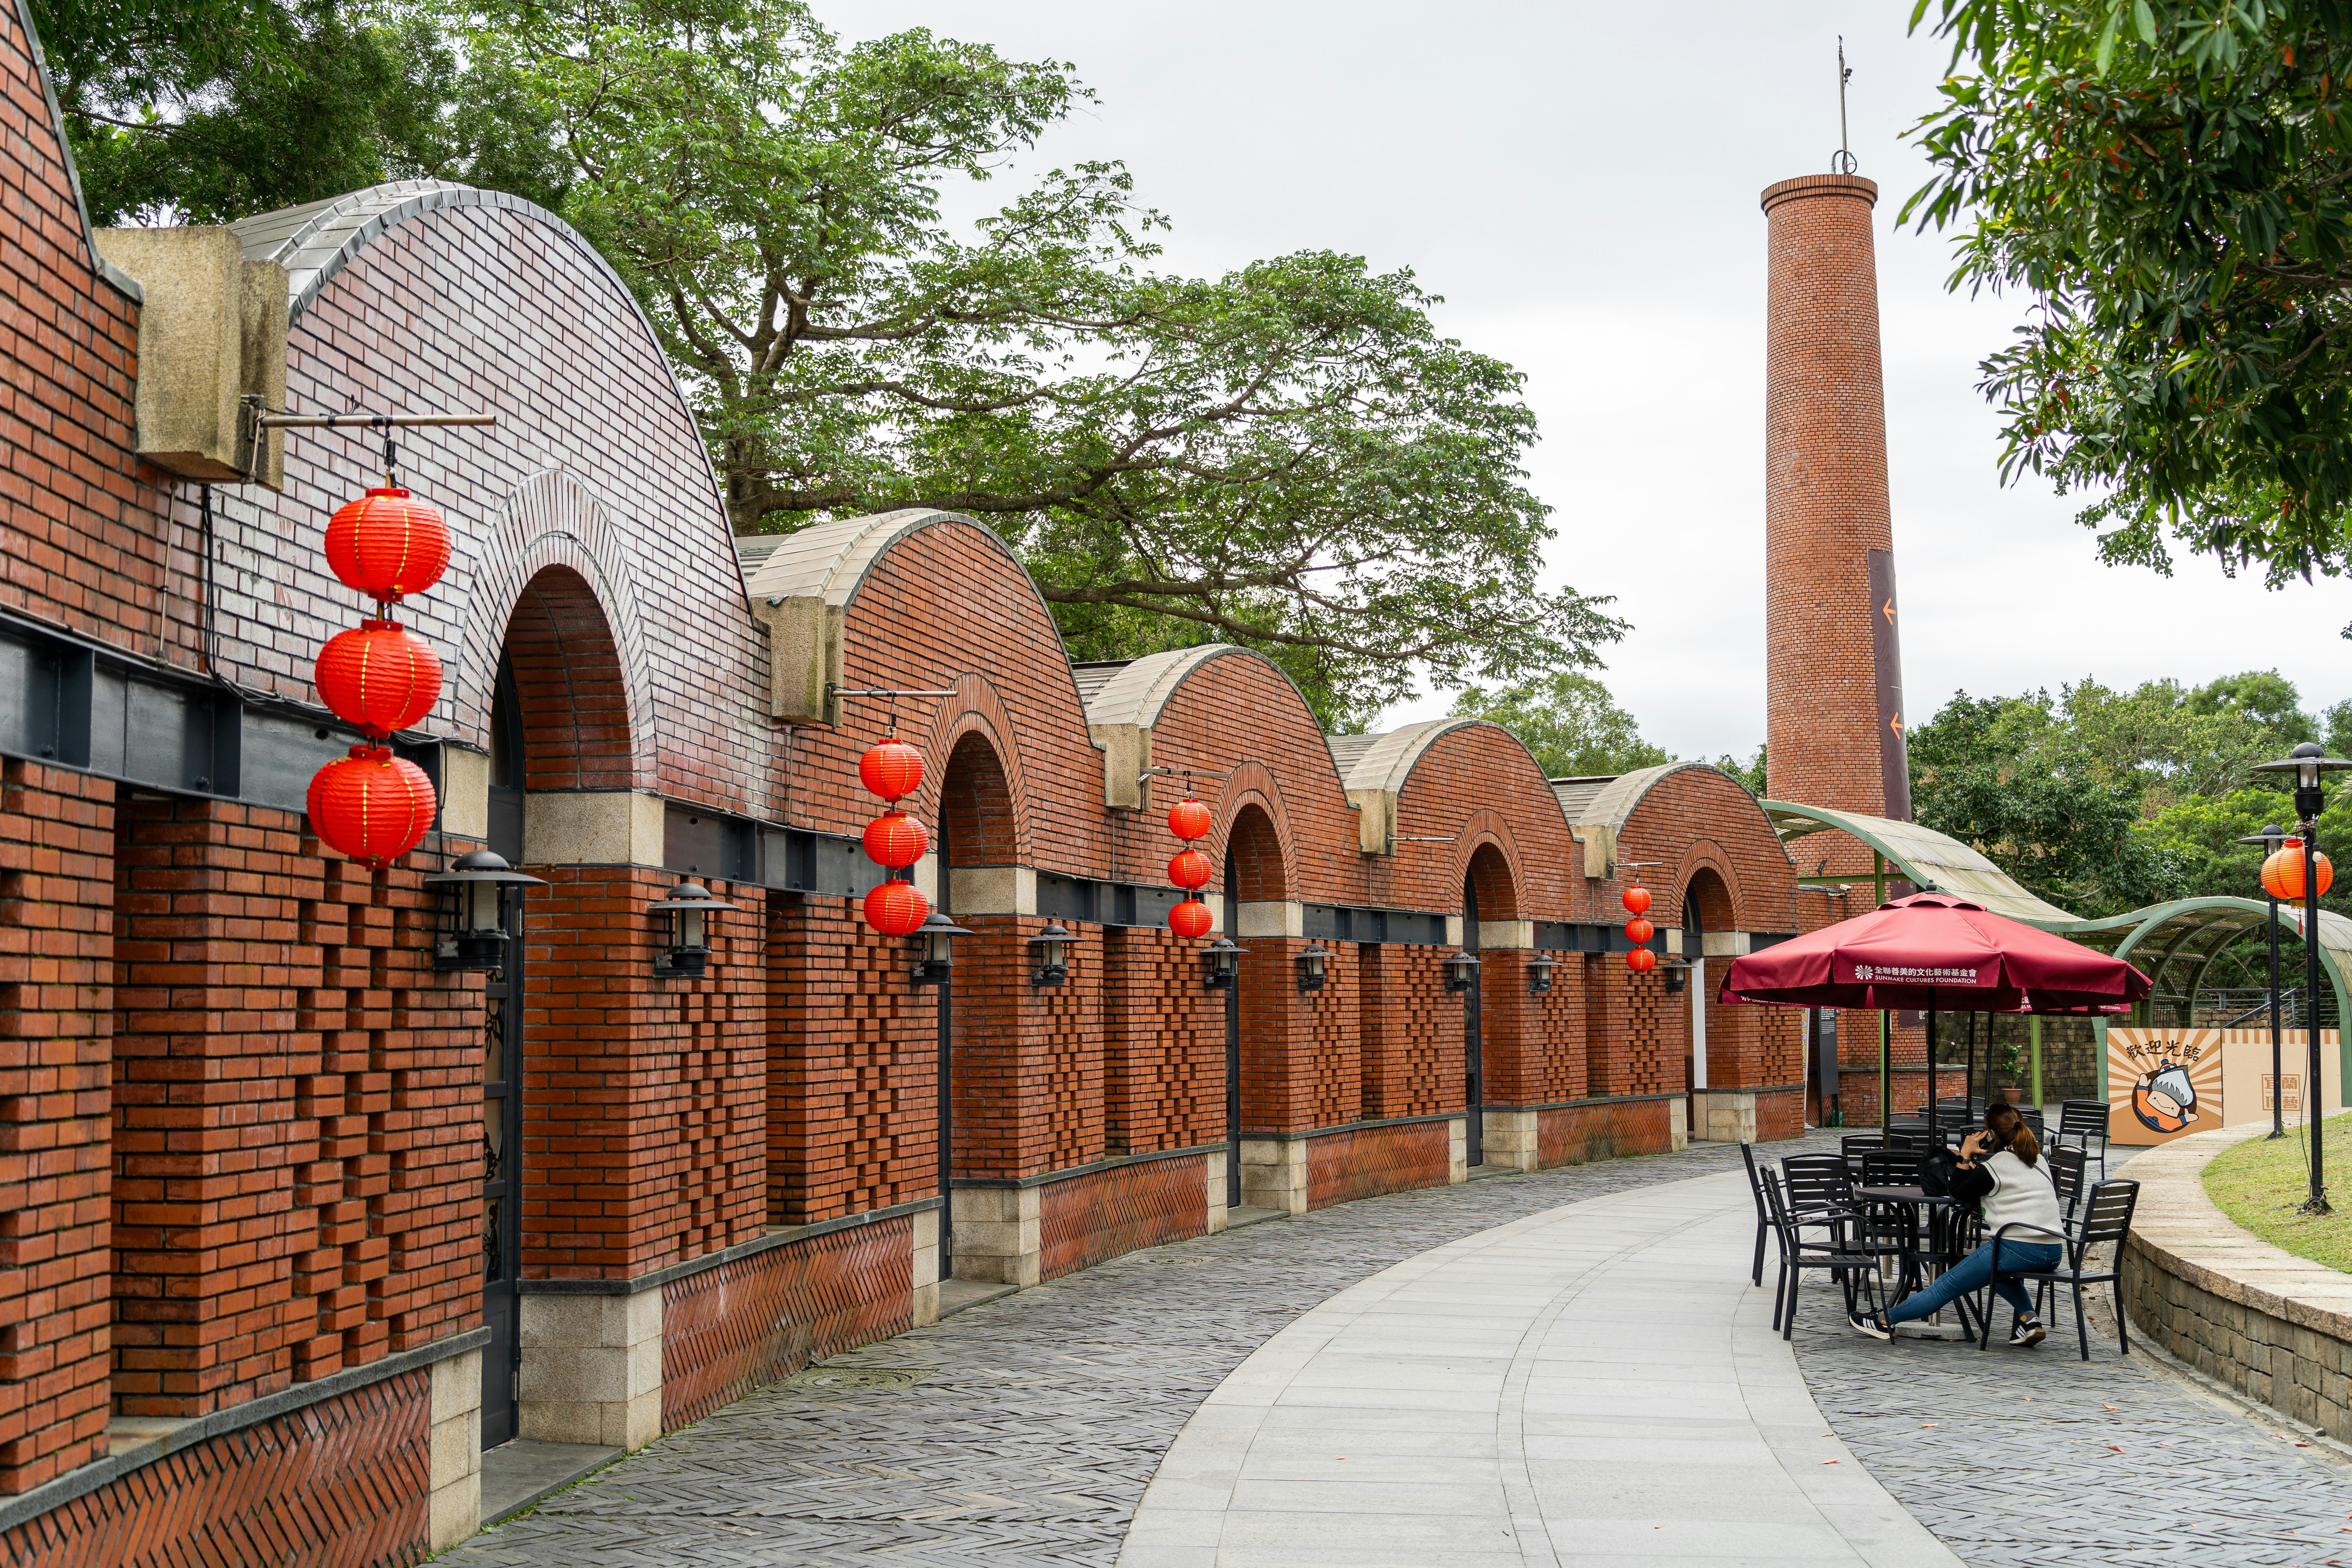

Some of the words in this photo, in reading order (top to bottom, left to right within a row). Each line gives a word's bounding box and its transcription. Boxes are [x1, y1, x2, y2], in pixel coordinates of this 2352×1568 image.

[1875, 967, 1977, 977] 全聯善美的文化藝術基金會
[2126, 1040, 2201, 1062] 歡迎光臨
